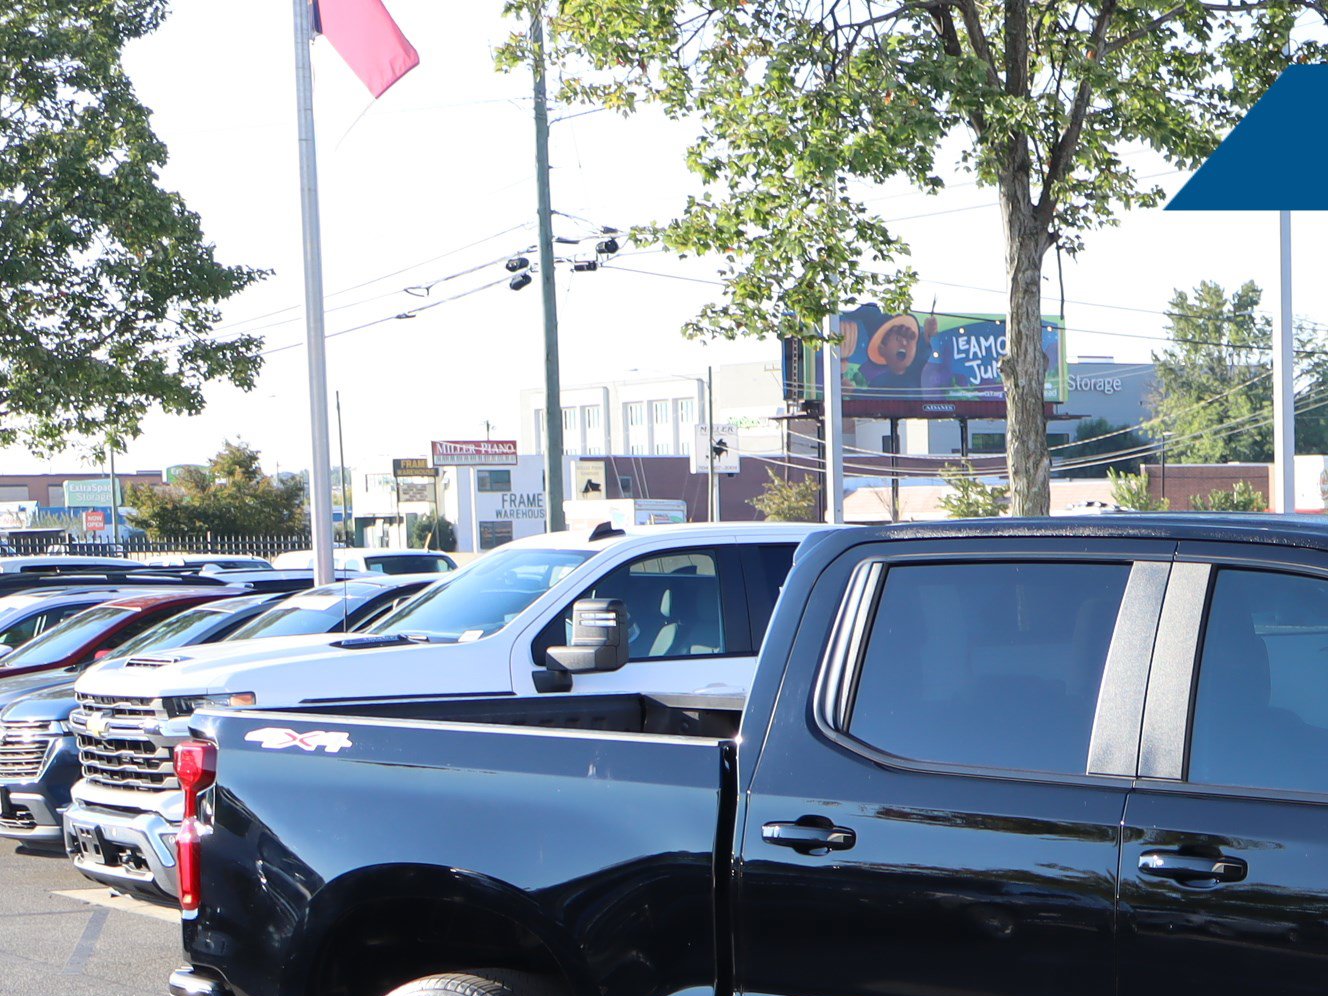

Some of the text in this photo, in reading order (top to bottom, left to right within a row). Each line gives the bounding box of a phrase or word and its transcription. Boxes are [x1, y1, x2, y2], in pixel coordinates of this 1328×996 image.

[952, 335, 1007, 360] LEAMO
[1067, 374, 1122, 394] Storage
[436, 442, 516, 454] MILLER PIANO
[501, 493, 544, 509] FRAME
[495, 508, 546, 519] WAREHOUS
